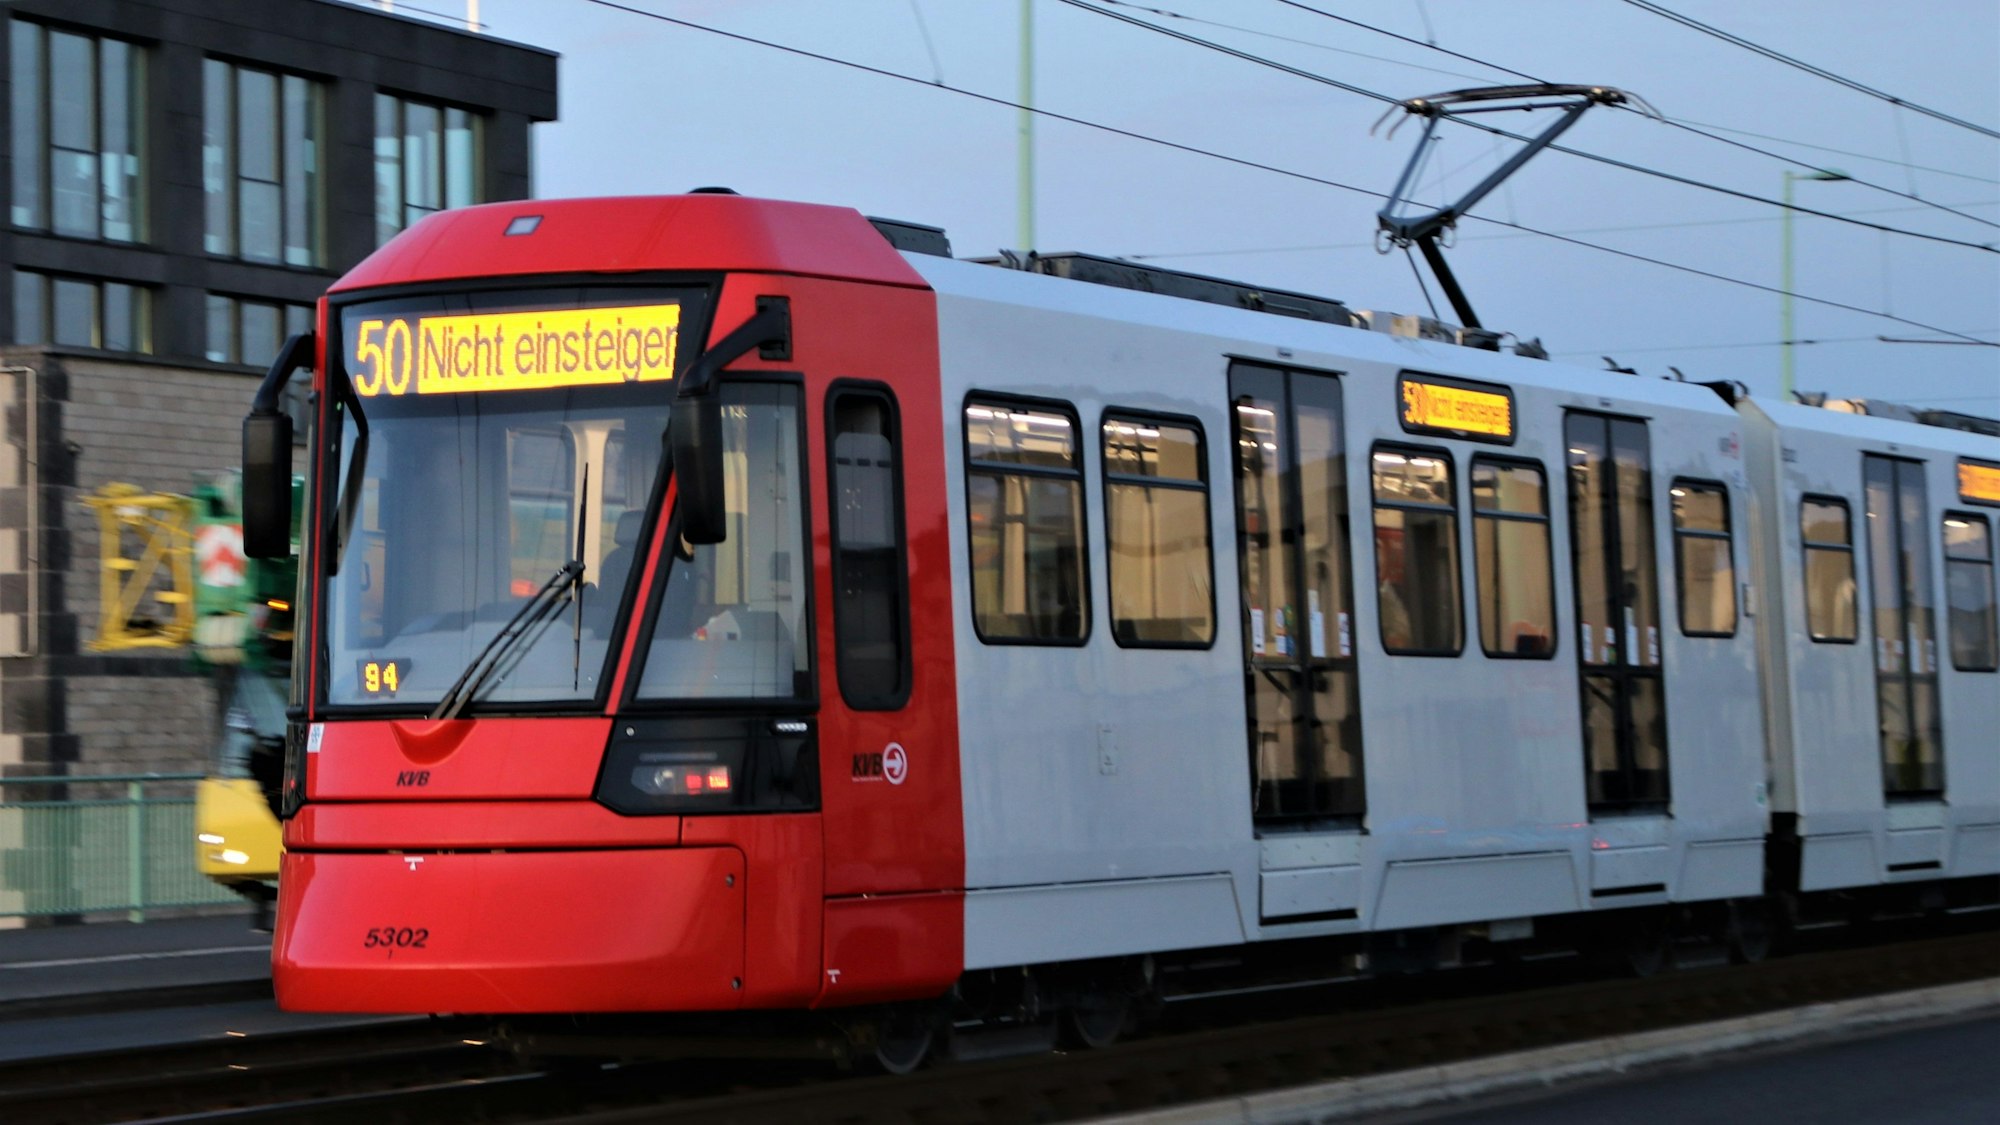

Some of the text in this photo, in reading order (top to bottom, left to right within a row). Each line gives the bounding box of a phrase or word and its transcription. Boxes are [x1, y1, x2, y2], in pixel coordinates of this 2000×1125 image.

[355, 318, 412, 397] 50
[423, 323, 504, 379] Nicht
[365, 662, 399, 692] 94
[852, 752, 883, 777] KVB
[396, 770, 431, 787] KVB
[364, 927, 429, 949] 5302
